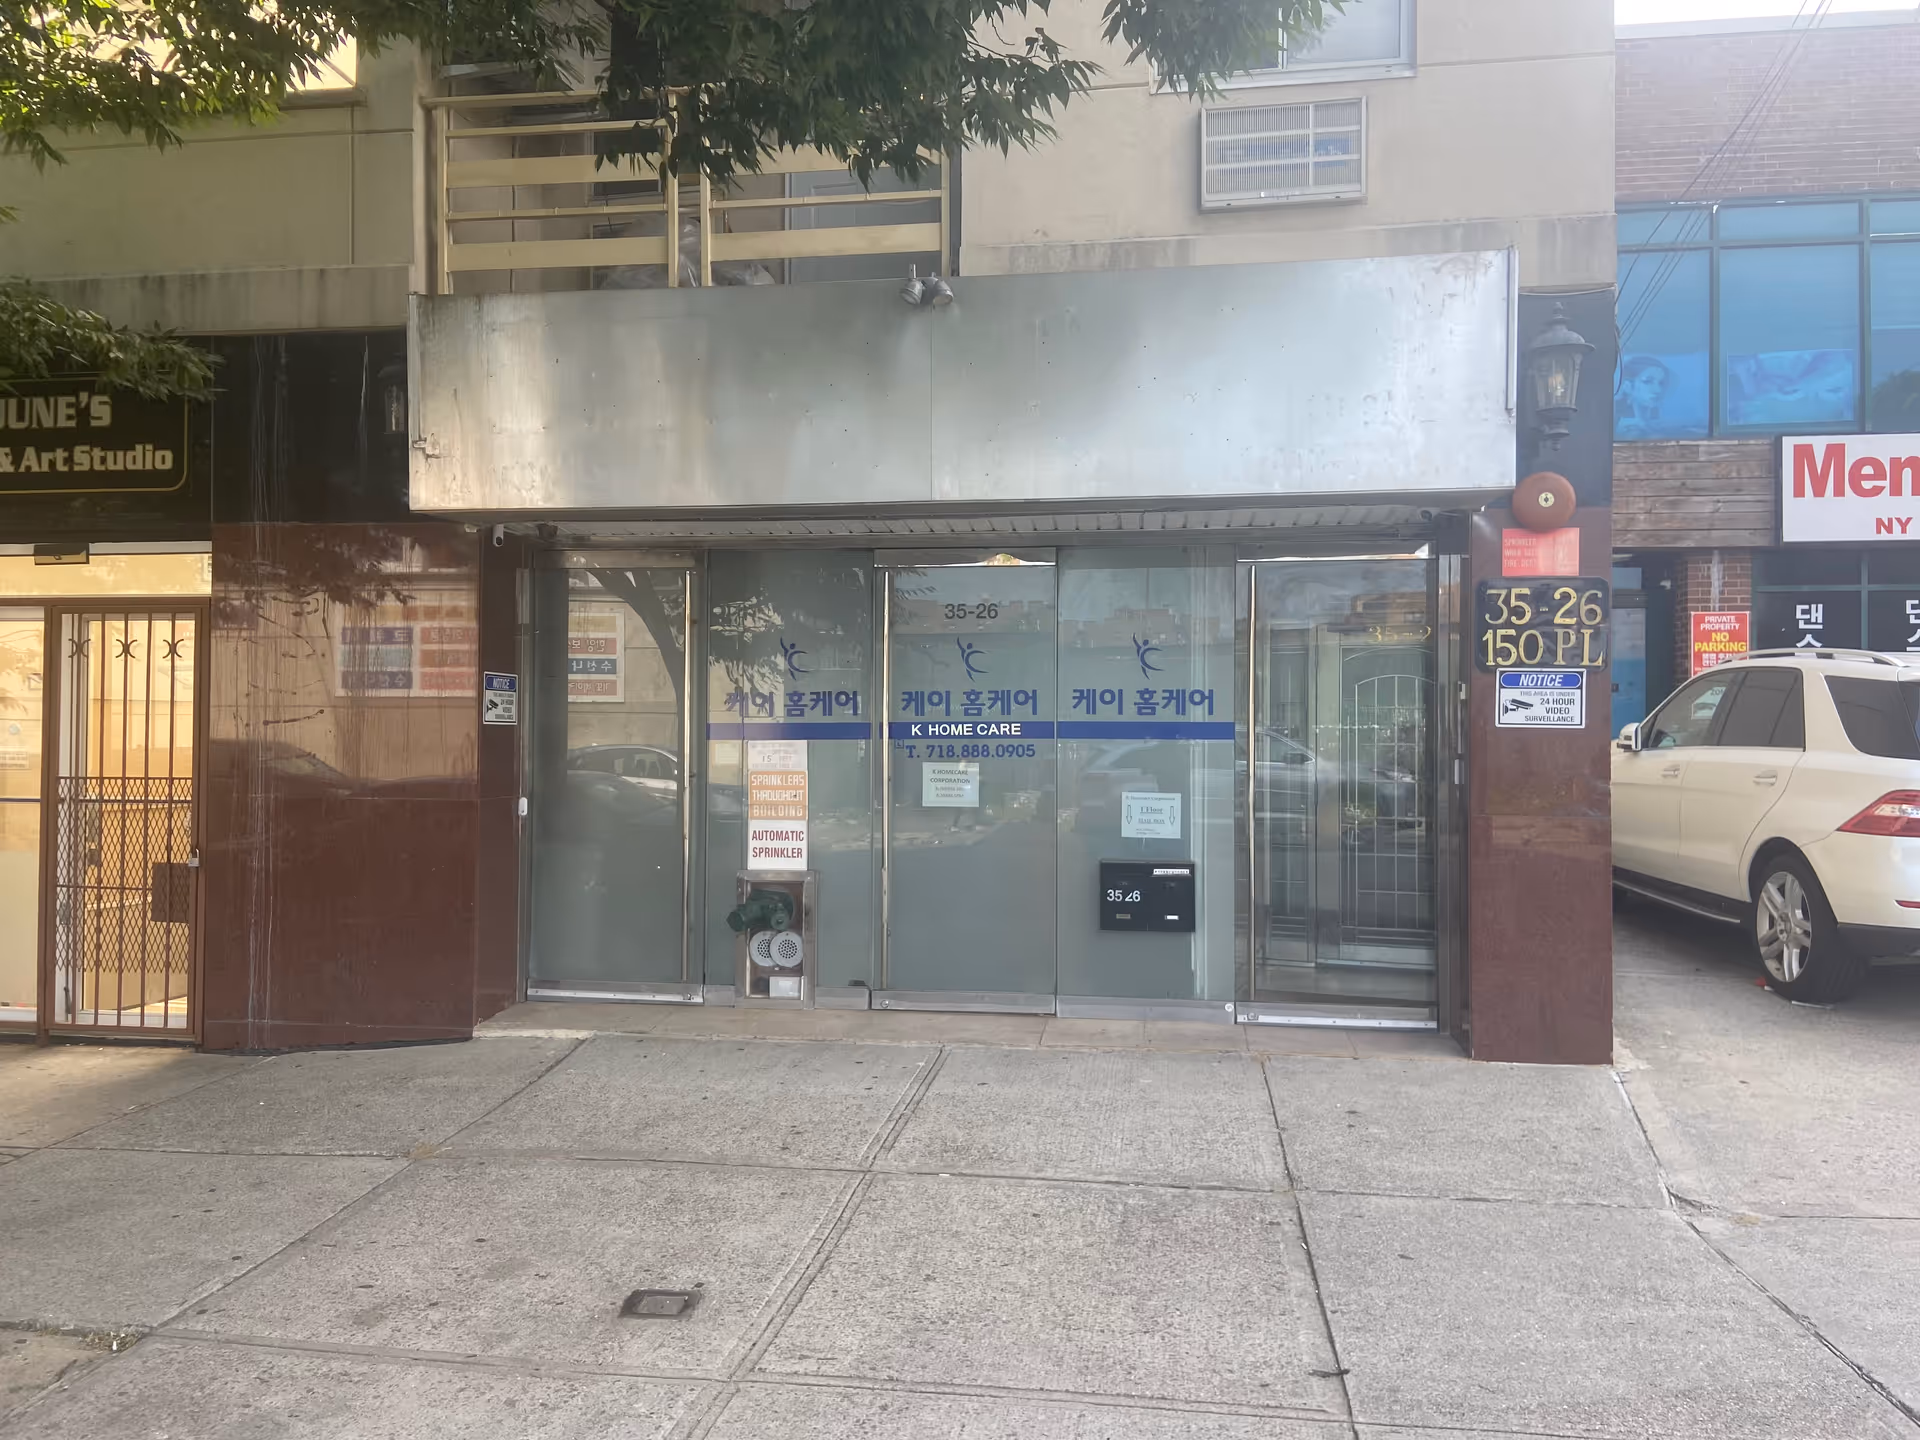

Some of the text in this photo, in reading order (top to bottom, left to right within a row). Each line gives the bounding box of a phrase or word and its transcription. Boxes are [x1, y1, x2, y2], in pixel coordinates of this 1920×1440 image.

[18, 446, 69, 472] Art
[73, 443, 173, 471] Studio
[1875, 516, 1913, 534] NY
[944, 603, 998, 619] 35-26
[1704, 615, 1736, 623] PRIVATE
[1700, 623, 1740, 631] PROPERTY
[1711, 632, 1730, 642] NO
[1482, 628, 1604, 666] 150 PL
[1695, 642, 1747, 652] PARKING
[1519, 674, 1563, 686] NOTICE
[724, 690, 858, 718] 케이 홈케어
[901, 689, 1037, 716] 케이 홈케어
[1072, 688, 1214, 715] 케이 홈케어
[1540, 698, 1575, 706] 24 HOUR
[1545, 707, 1570, 715] VIDEO
[911, 723, 1021, 736] K HOME CARE
[905, 744, 1035, 758] T. 718.888.0905
[751, 774, 804, 786] SPRINKLERS
[752, 789, 804, 801] THROUGHOUT
[753, 804, 803, 817] BUILDING
[752, 830, 804, 842] AUTOMATIC
[752, 847, 803, 859] SPRINKLER
